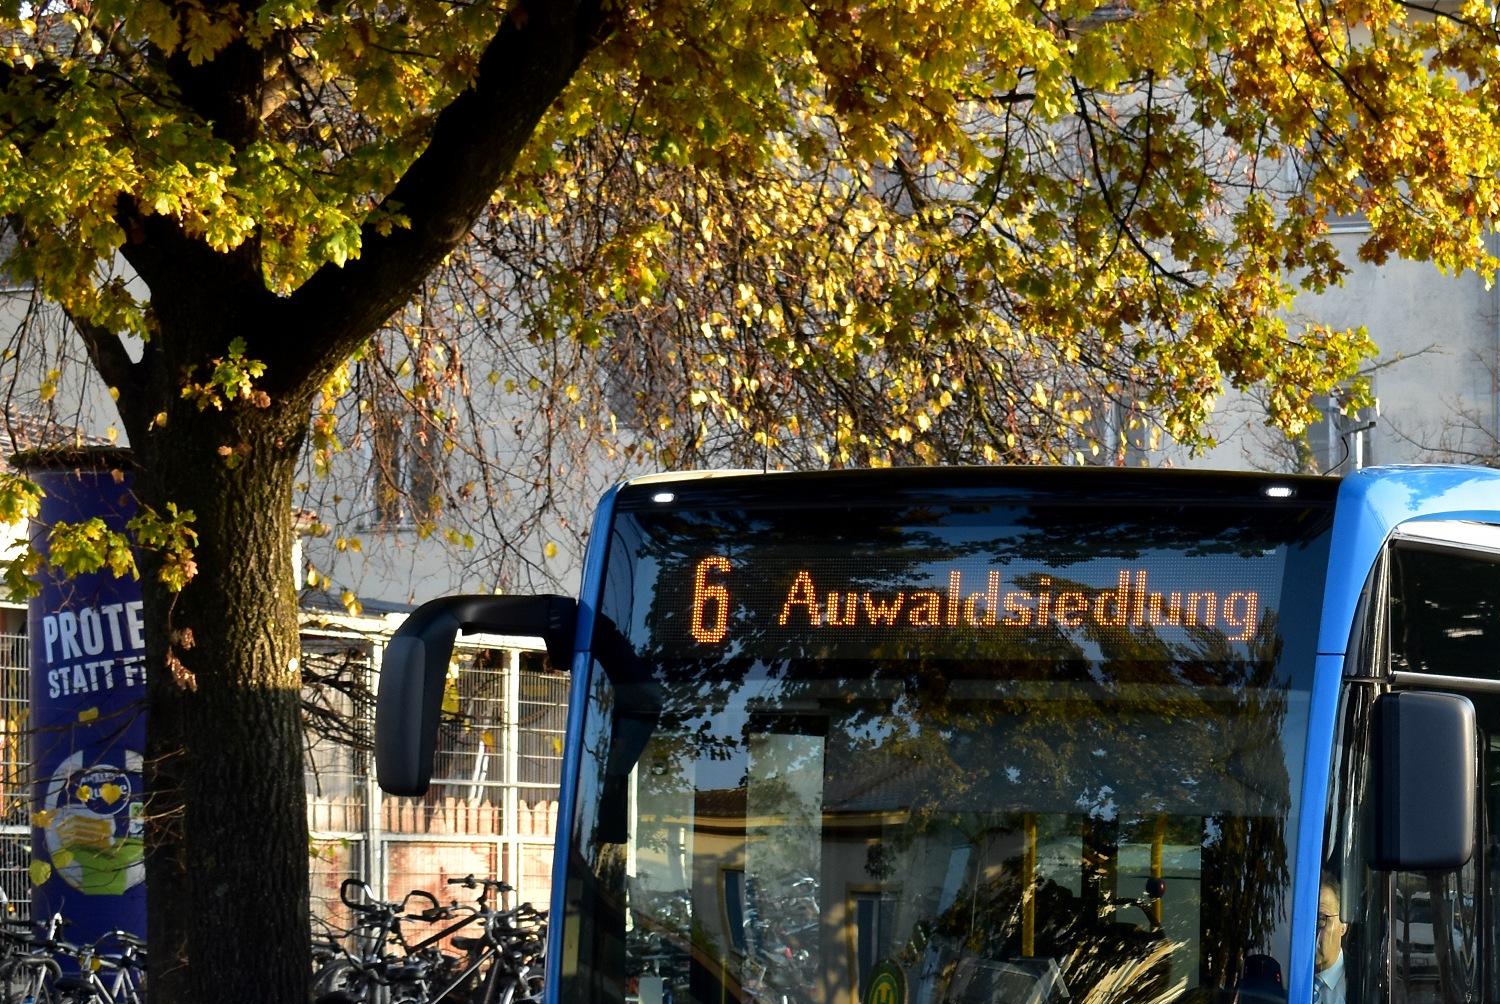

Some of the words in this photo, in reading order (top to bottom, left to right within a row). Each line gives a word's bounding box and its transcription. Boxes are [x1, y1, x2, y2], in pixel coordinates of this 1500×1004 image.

[692, 555, 732, 643] 6
[779, 570, 1260, 641] Auwaldsiedlung
[43, 600, 145, 663] PROTE
[48, 659, 115, 699] STATT
